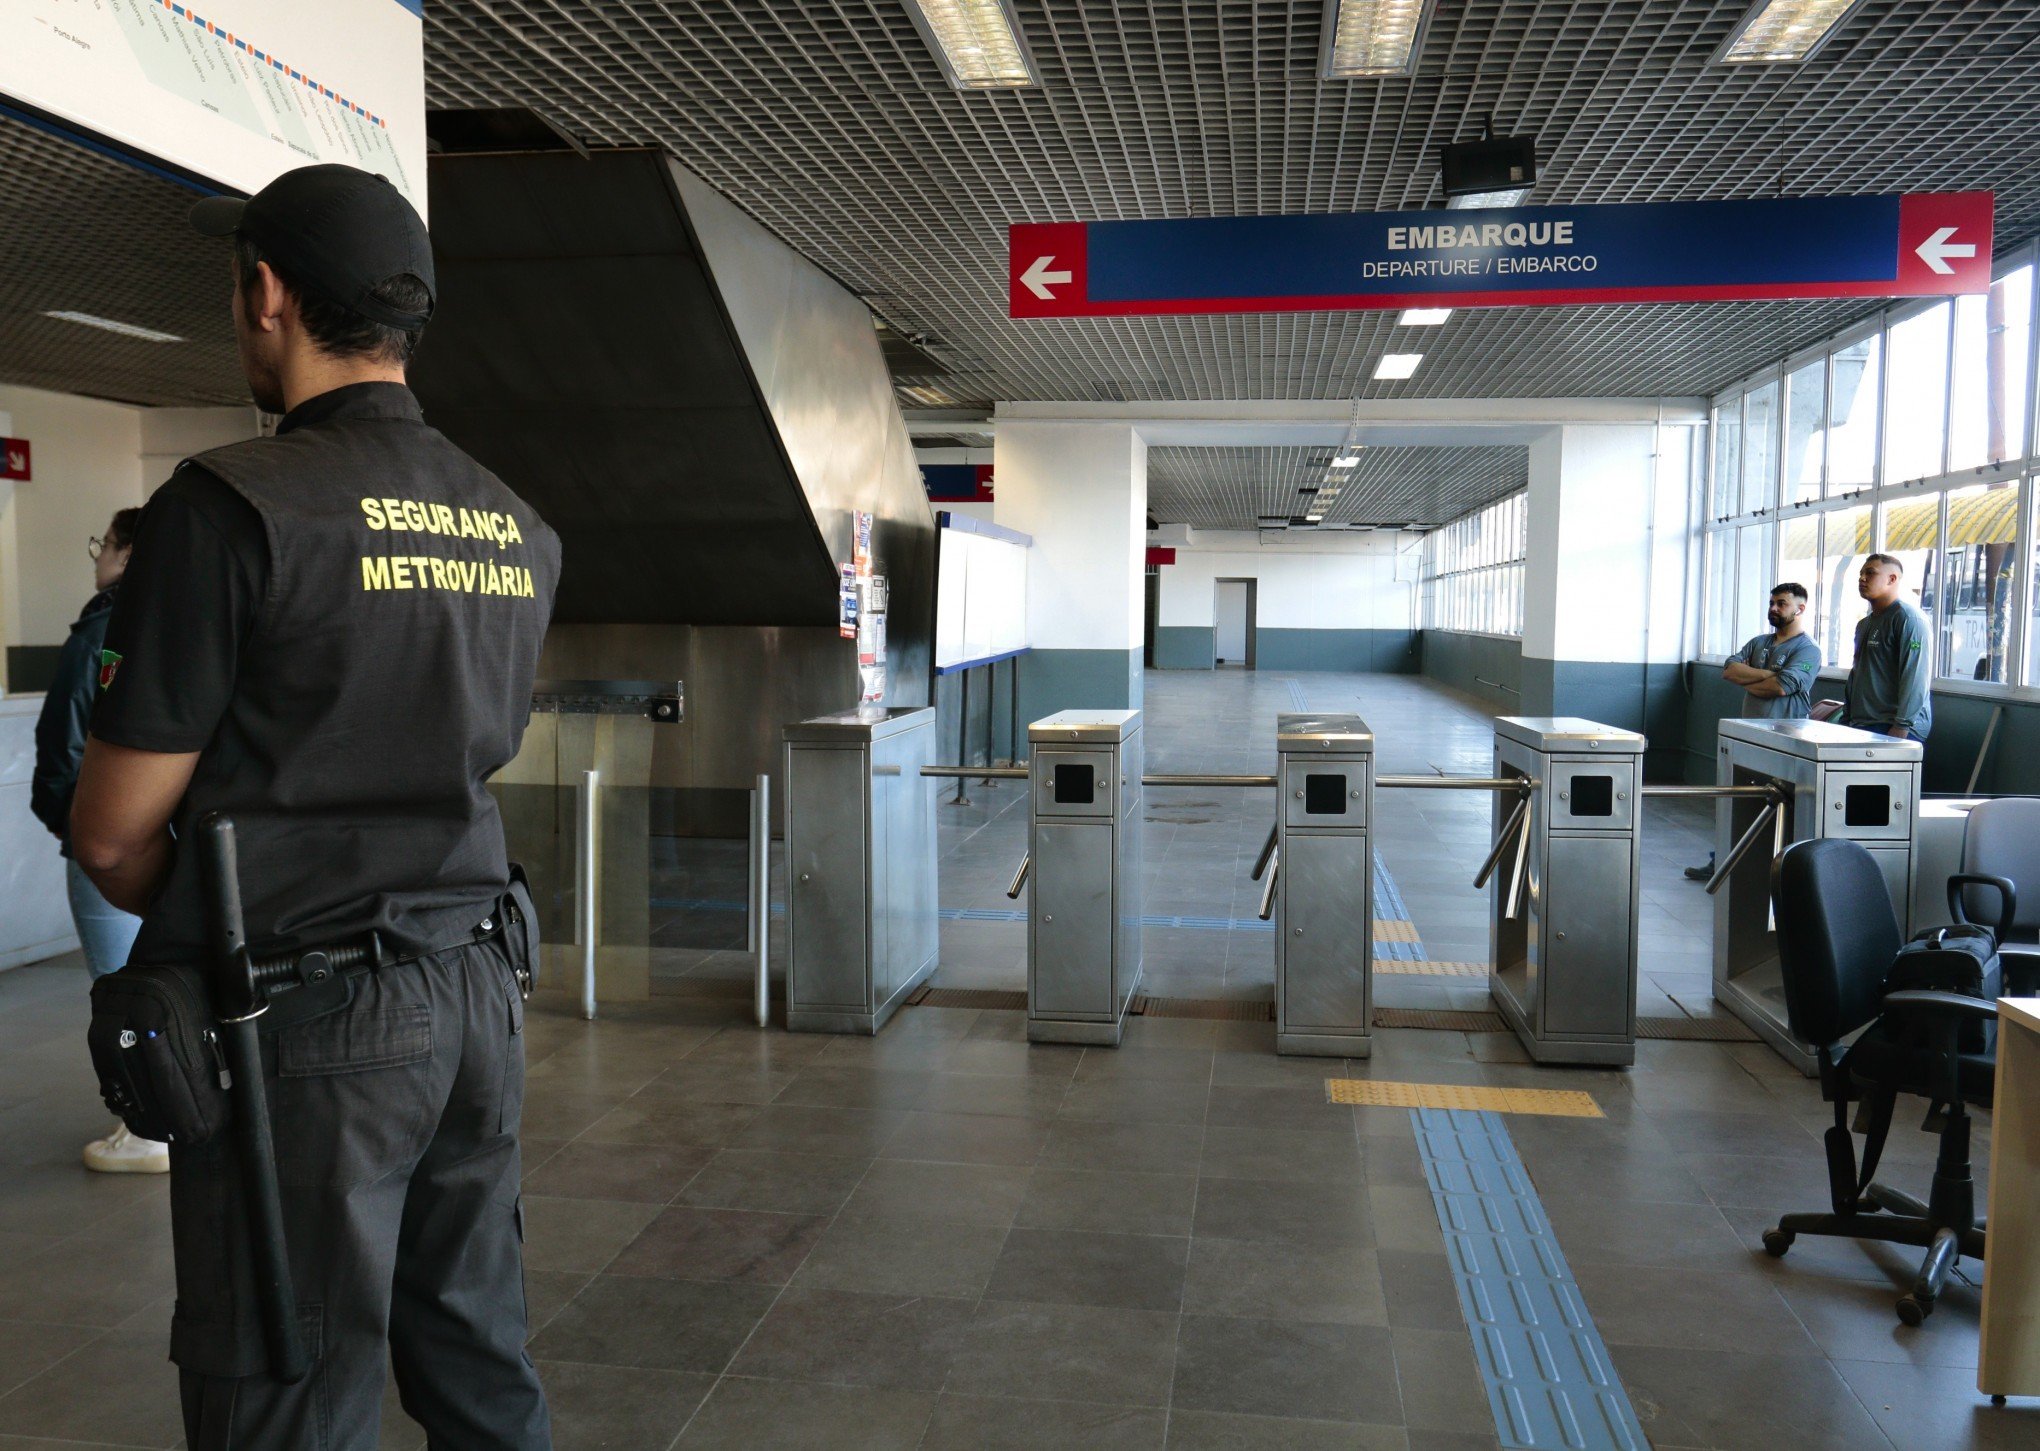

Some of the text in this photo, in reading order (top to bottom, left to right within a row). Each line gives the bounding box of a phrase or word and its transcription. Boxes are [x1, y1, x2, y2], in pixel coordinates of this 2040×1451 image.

[150, 4, 169, 43] Canoas
[172, 16, 206, 83] Mathias Velho
[215, 39, 237, 85] Petrobras
[1387, 220, 1574, 250] EMBARQUE
[1363, 258, 1480, 278] DEPARTURE
[1497, 255, 1598, 275] EMBARCO
[360, 497, 523, 550] SEGURANÇA
[361, 557, 535, 598] METROVIÁRIA
